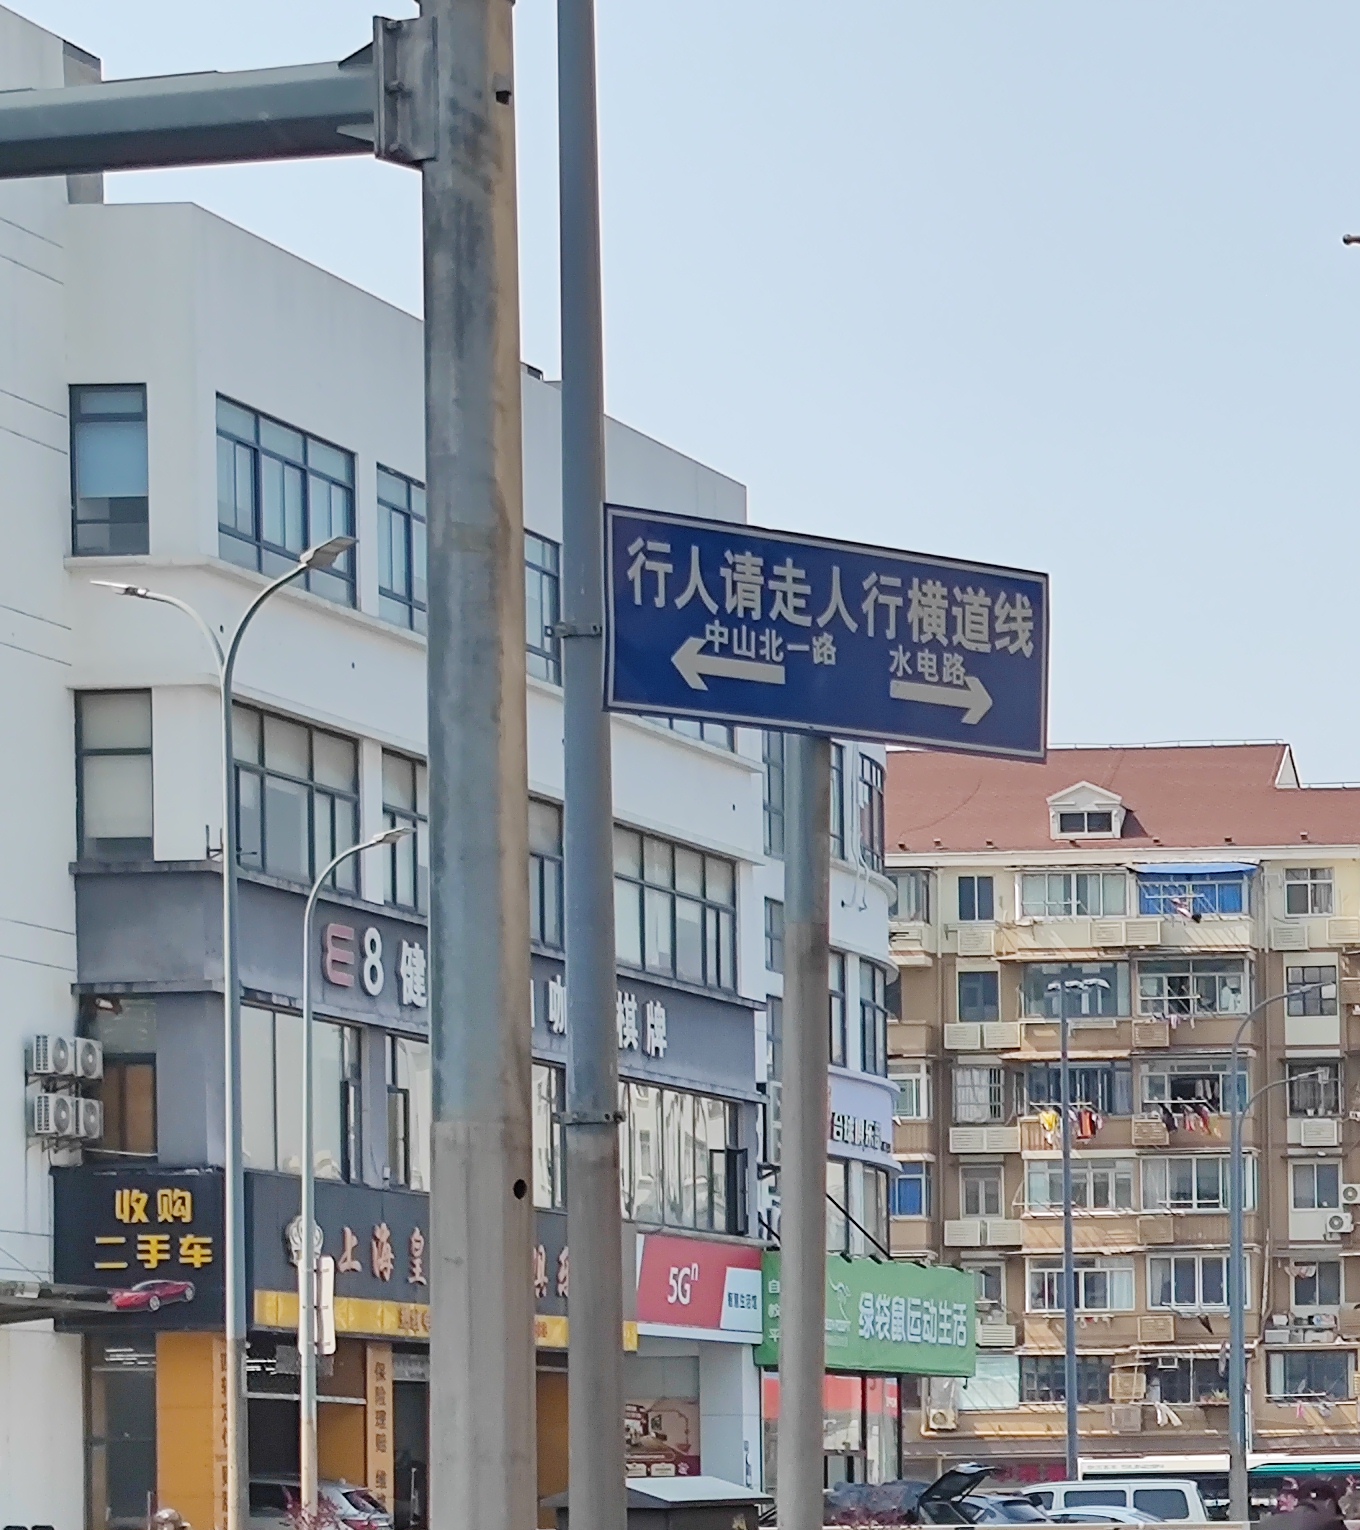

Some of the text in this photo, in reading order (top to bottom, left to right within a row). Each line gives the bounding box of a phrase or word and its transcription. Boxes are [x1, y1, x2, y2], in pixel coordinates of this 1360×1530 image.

[626, 536, 1035, 659] 行人请走人行横道线
[704, 618, 967, 687] 中山北一路 水电路
[115, 1187, 193, 1224] 收购
[94, 1234, 213, 1270] 二手车
[858, 1290, 967, 1347] 绿袋鼠运动生活
